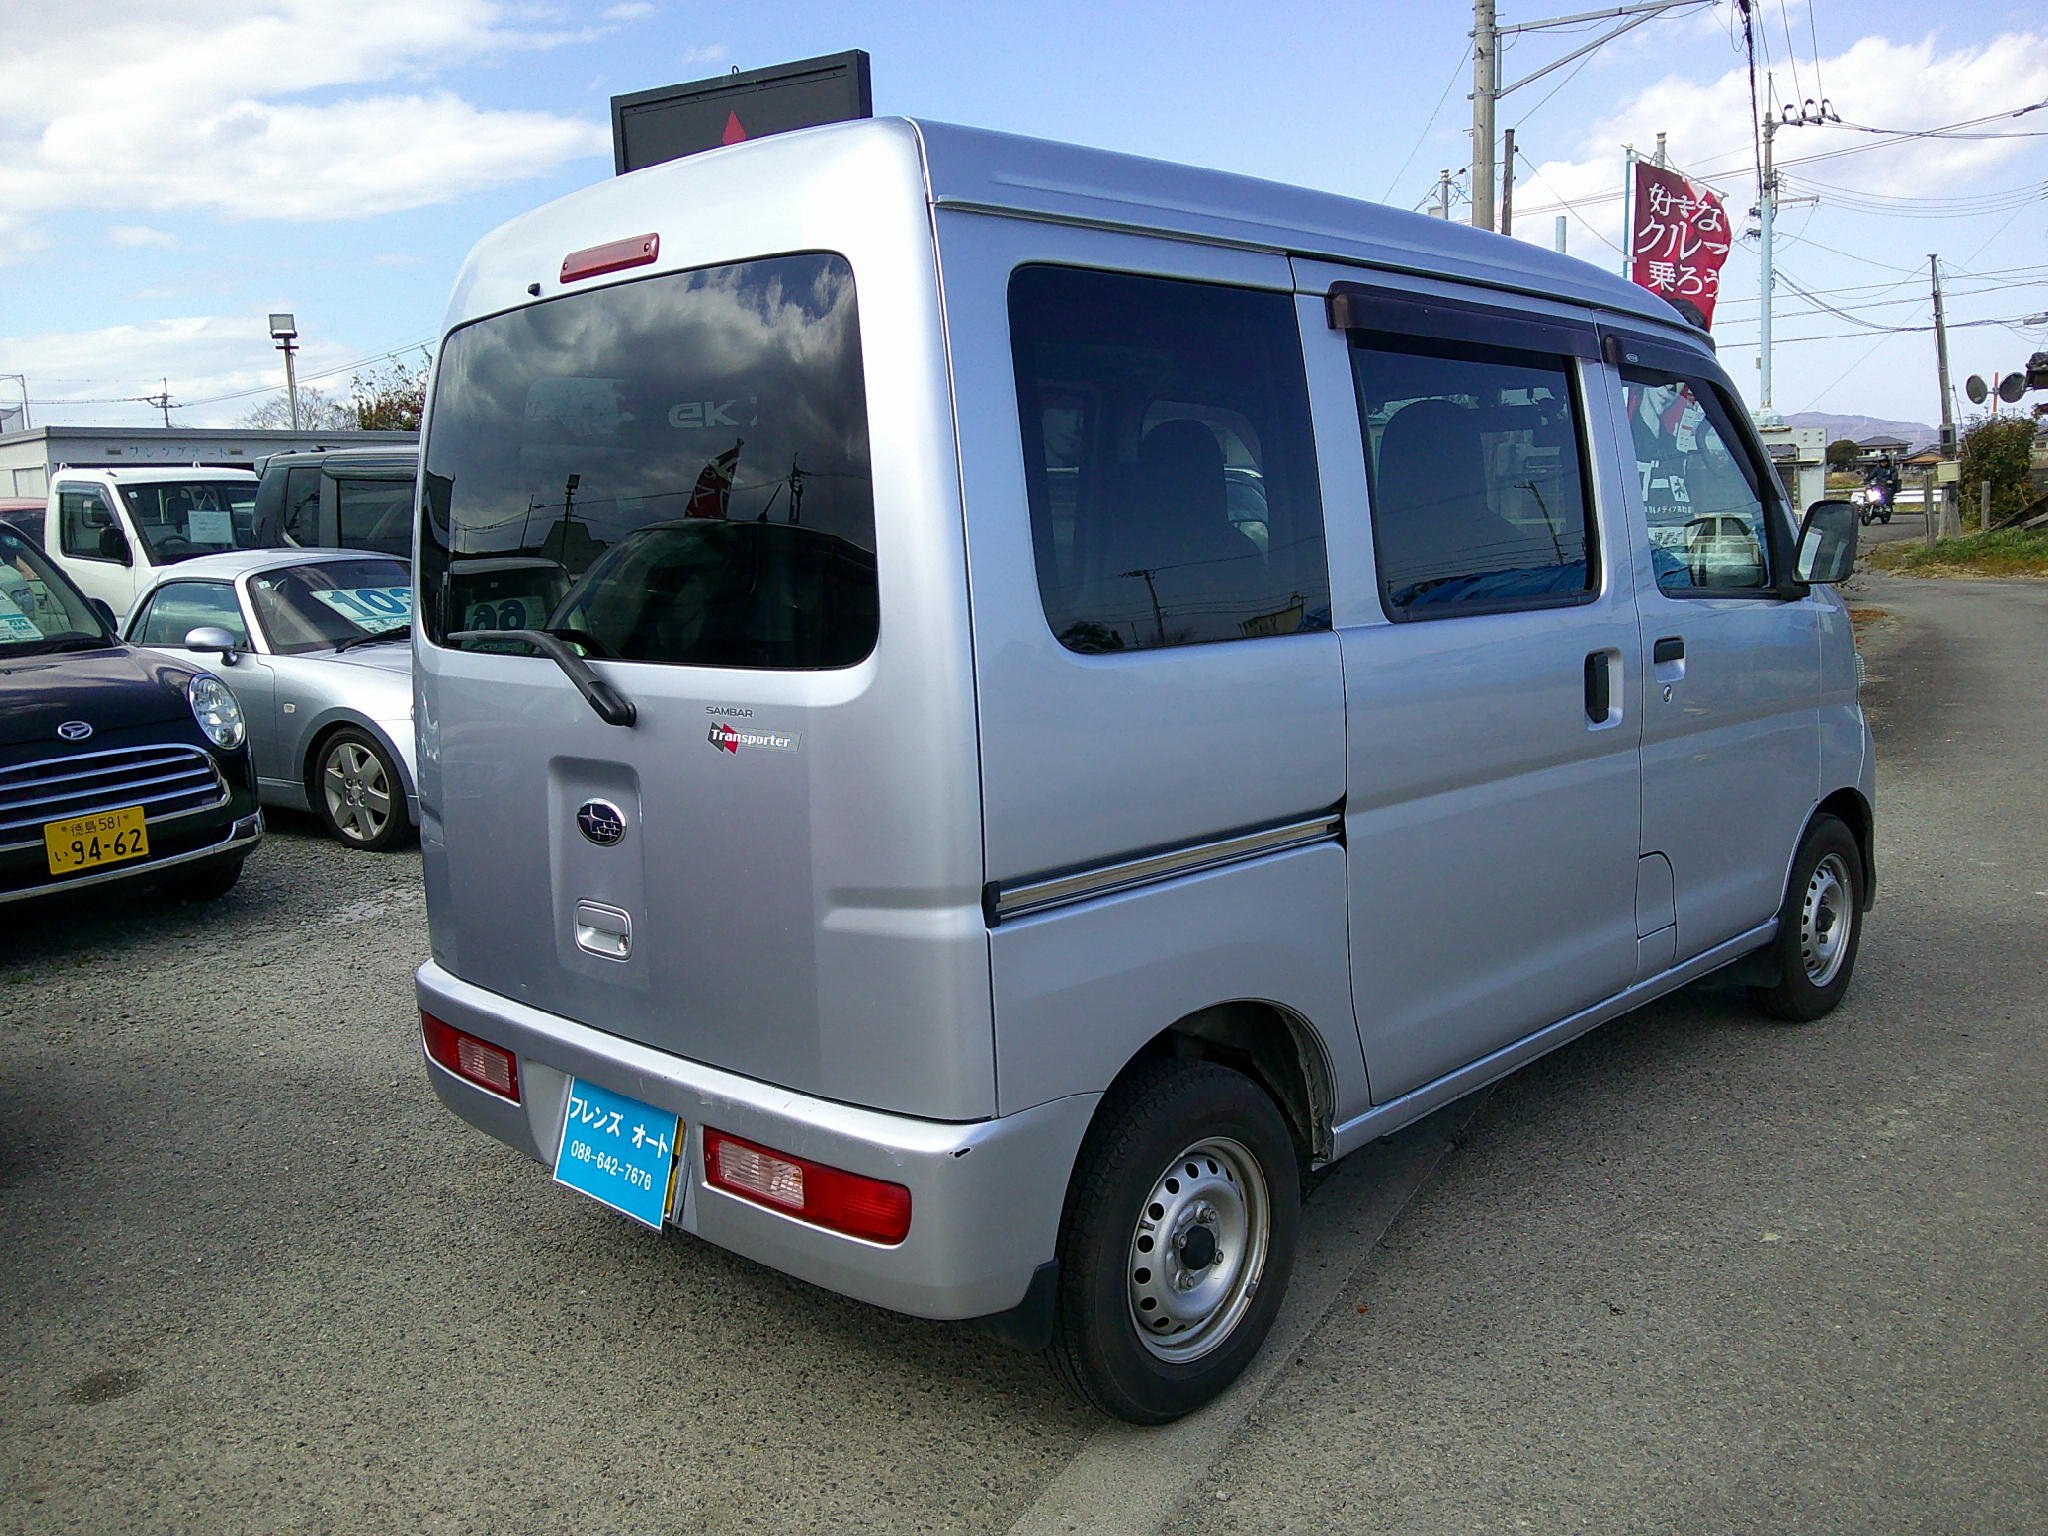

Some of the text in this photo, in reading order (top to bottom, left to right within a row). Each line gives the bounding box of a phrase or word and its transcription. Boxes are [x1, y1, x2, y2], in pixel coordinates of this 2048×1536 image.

[1649, 183, 1722, 232] 好きな
[1648, 261, 1720, 299] 乗ろう
[706, 706, 753, 718] SAMBAR
[711, 729, 791, 748] Transporter
[71, 829, 144, 865] 94-62
[570, 1096, 669, 1158] フレンズ オート
[570, 1140, 652, 1191] 088-642-7676
